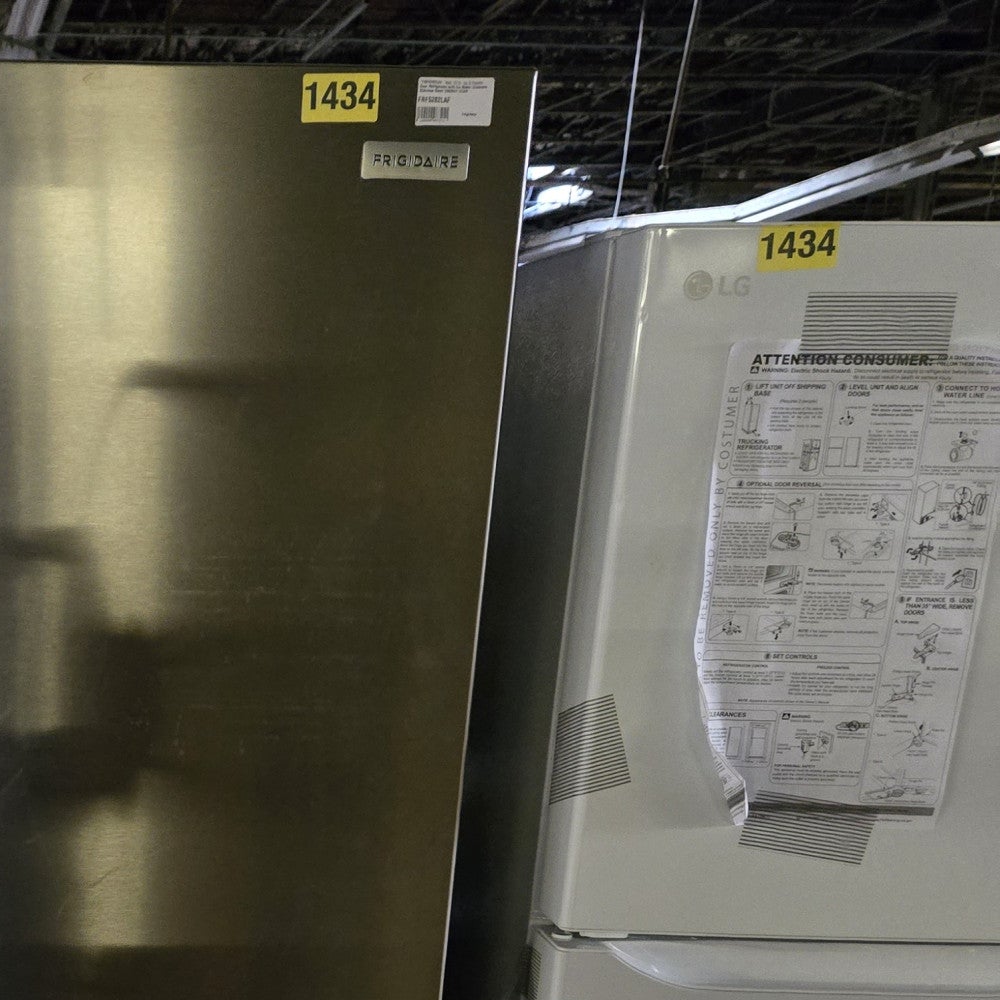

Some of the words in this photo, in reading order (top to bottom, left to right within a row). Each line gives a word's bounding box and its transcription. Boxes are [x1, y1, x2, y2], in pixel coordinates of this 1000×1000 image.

[304, 80, 376, 110] 1434
[372, 154, 459, 169] FRIGIDAIRE
[761, 229, 836, 260] 1434
[717, 275, 751, 297] LG
[751, 353, 838, 366] ATTENTION
[718, 386, 740, 470] COSTUMER
[713, 477, 726, 495] BY
[710, 504, 722, 541] ONLY
